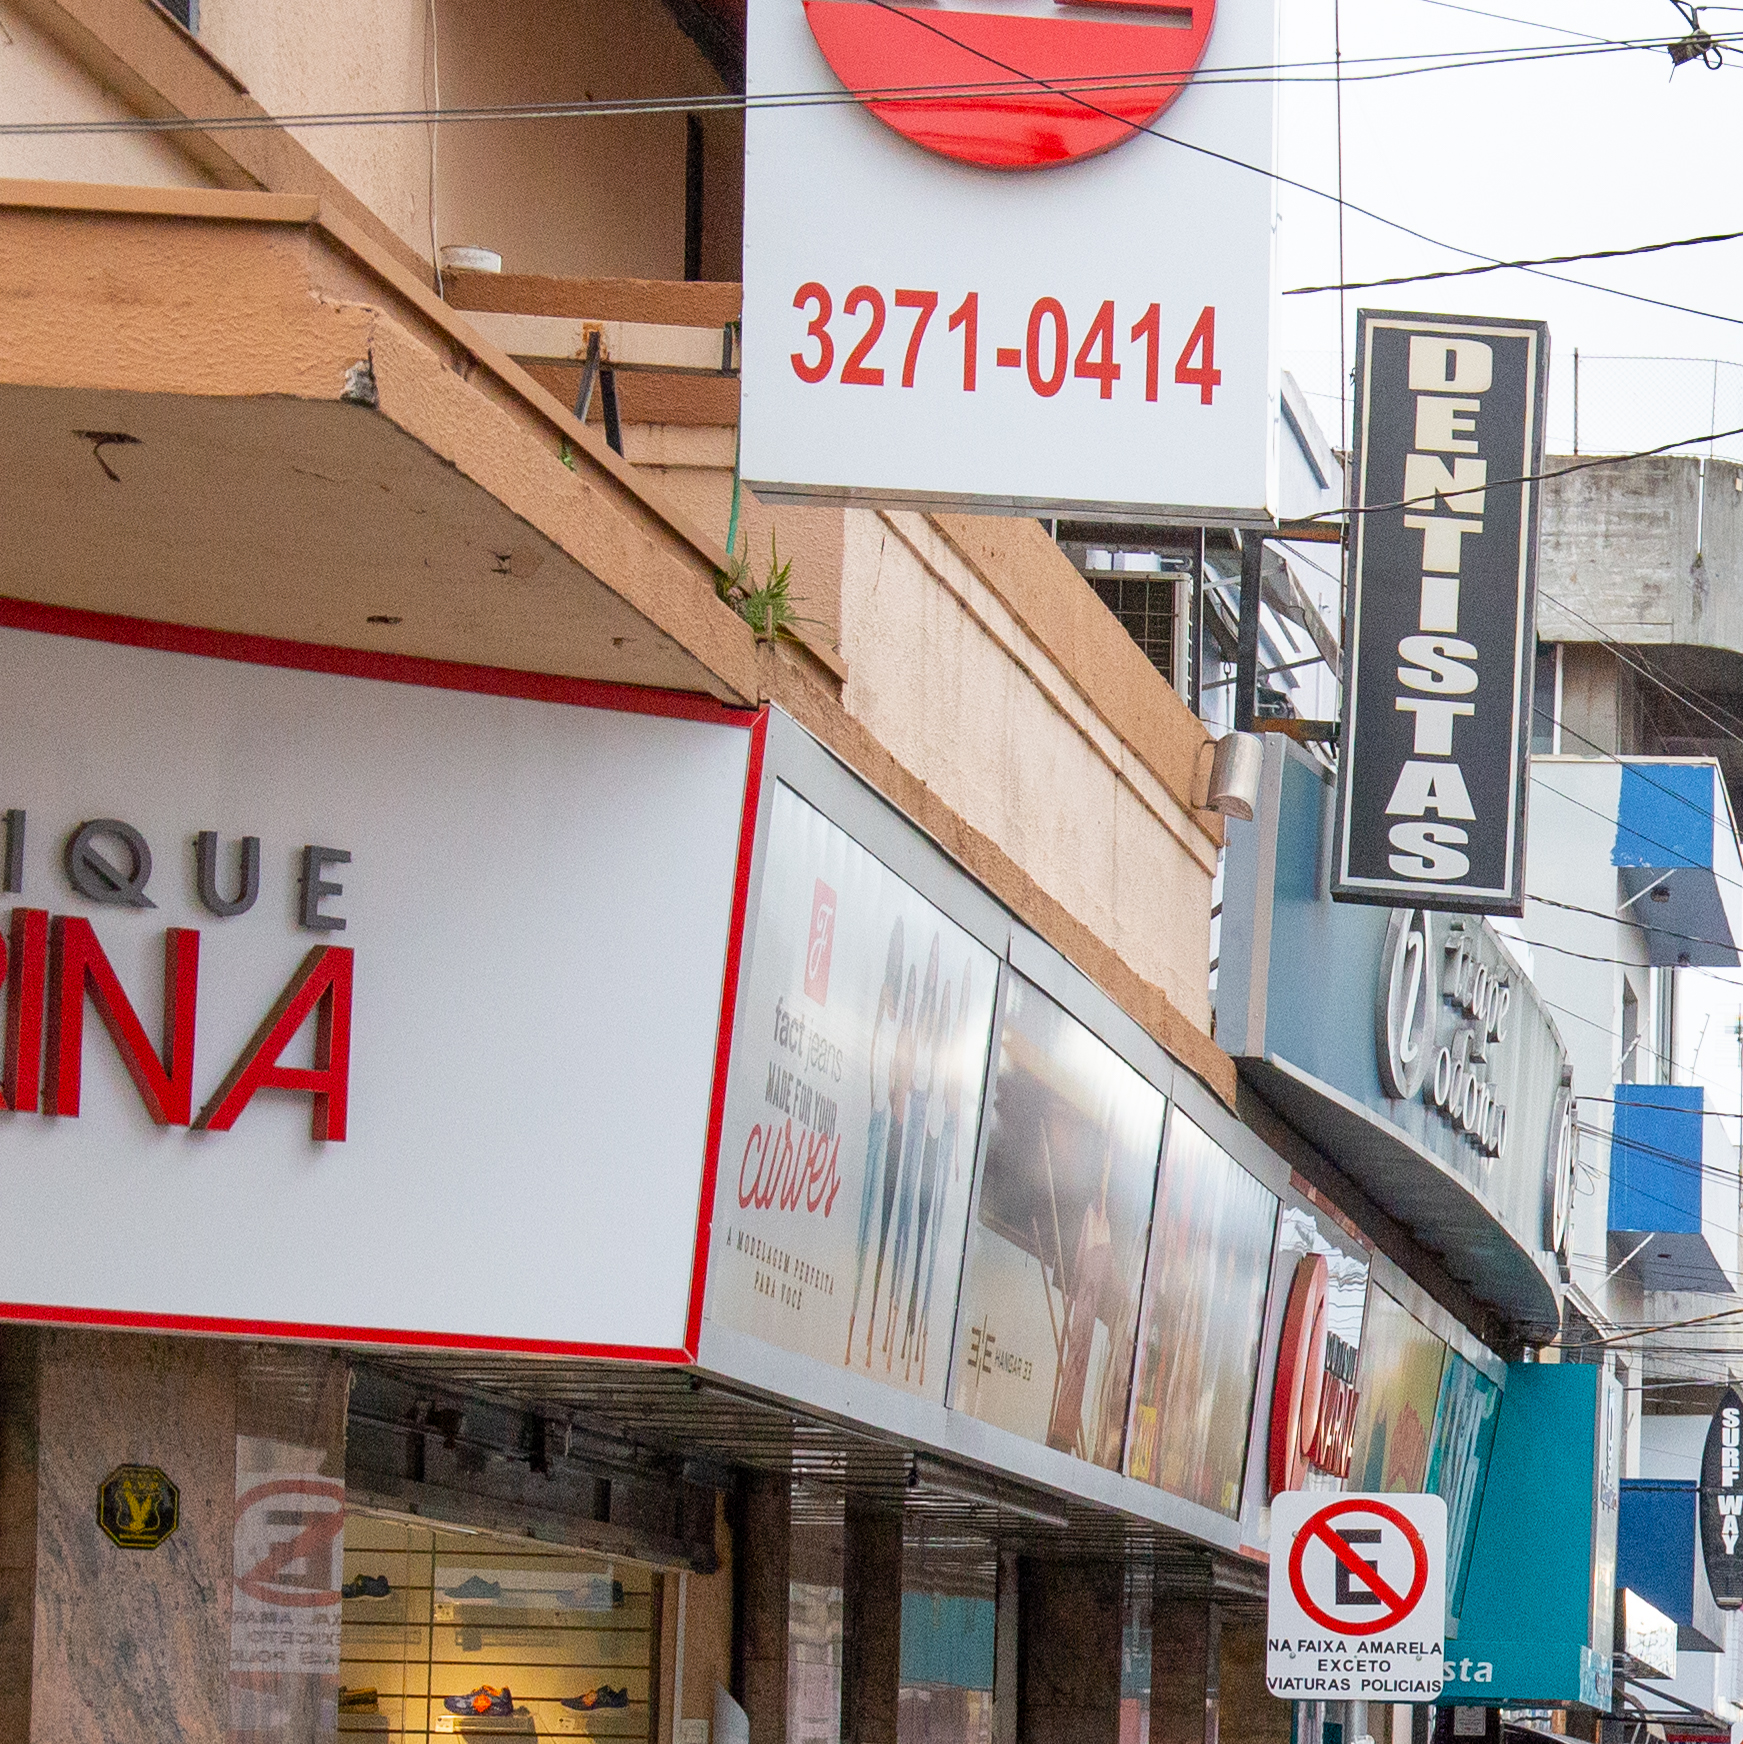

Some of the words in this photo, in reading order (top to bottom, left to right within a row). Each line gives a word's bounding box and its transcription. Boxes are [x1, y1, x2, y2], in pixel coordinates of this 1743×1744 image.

[789, 281, 1221, 405] 3271-0414
[1384, 335, 1493, 880] DENTISTAS
[0, 906, 354, 1142] INA
[773, 997, 804, 1058] fact
[804, 1034, 844, 1083] jeans
[765, 1061, 791, 1114] MADE
[792, 1076, 813, 1124] FOR
[814, 1089, 838, 1140] YOUR
[738, 1118, 842, 1218] curves
[737, 1231, 790, 1277] MODELAGEM
[793, 1257, 835, 1296] PERFEITA
[754, 1270, 777, 1295] PARA
[780, 1283, 802, 1311] VOCÊ
[995, 1348, 1022, 1377] HANGAR
[1022, 1361, 1032, 1381] 33
[1721, 1407, 1740, 1487] SURF
[1717, 1494, 1743, 1554] WAY
[1336, 1529, 1382, 1605] E
[1268, 1677, 1351, 1691] VIATURAS
[1361, 1679, 1442, 1693] POLICIAIS
[1269, 1639, 1291, 1652] NA
[1298, 1640, 1347, 1653] FAIXA
[1357, 1641, 1442, 1655] AMARELA
[1317, 1659, 1391, 1673] EXCETO
